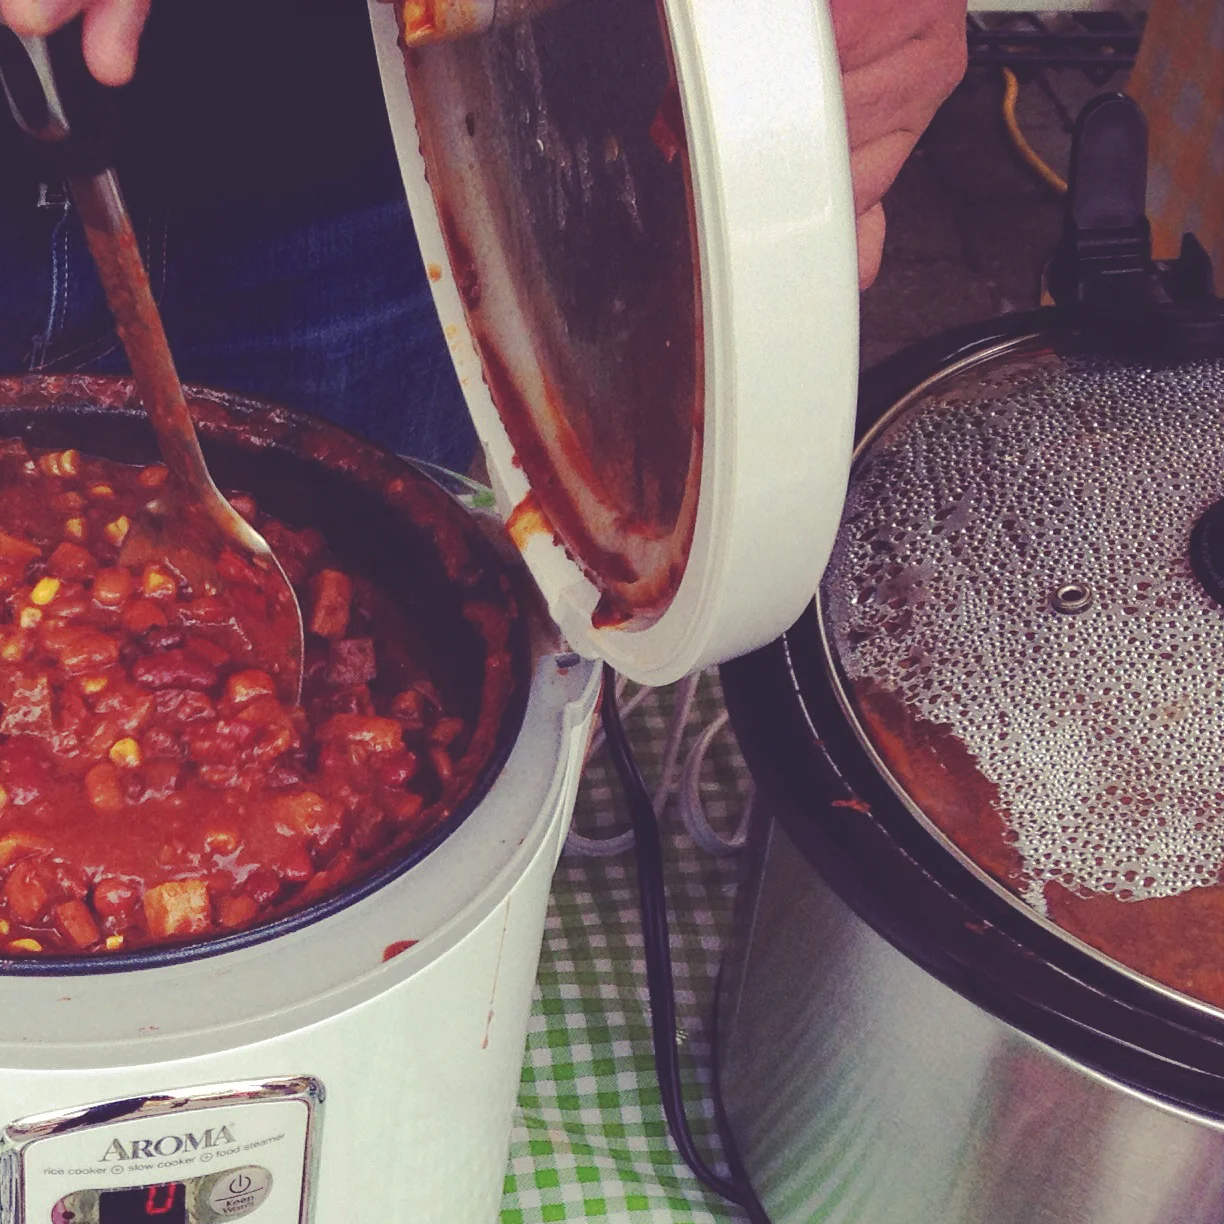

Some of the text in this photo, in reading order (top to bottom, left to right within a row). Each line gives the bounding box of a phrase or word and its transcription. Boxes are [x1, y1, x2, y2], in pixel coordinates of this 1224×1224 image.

[43, 1133, 286, 1175] rice cooker slow cooker food steamer
[98, 1125, 236, 1162] AROMA
